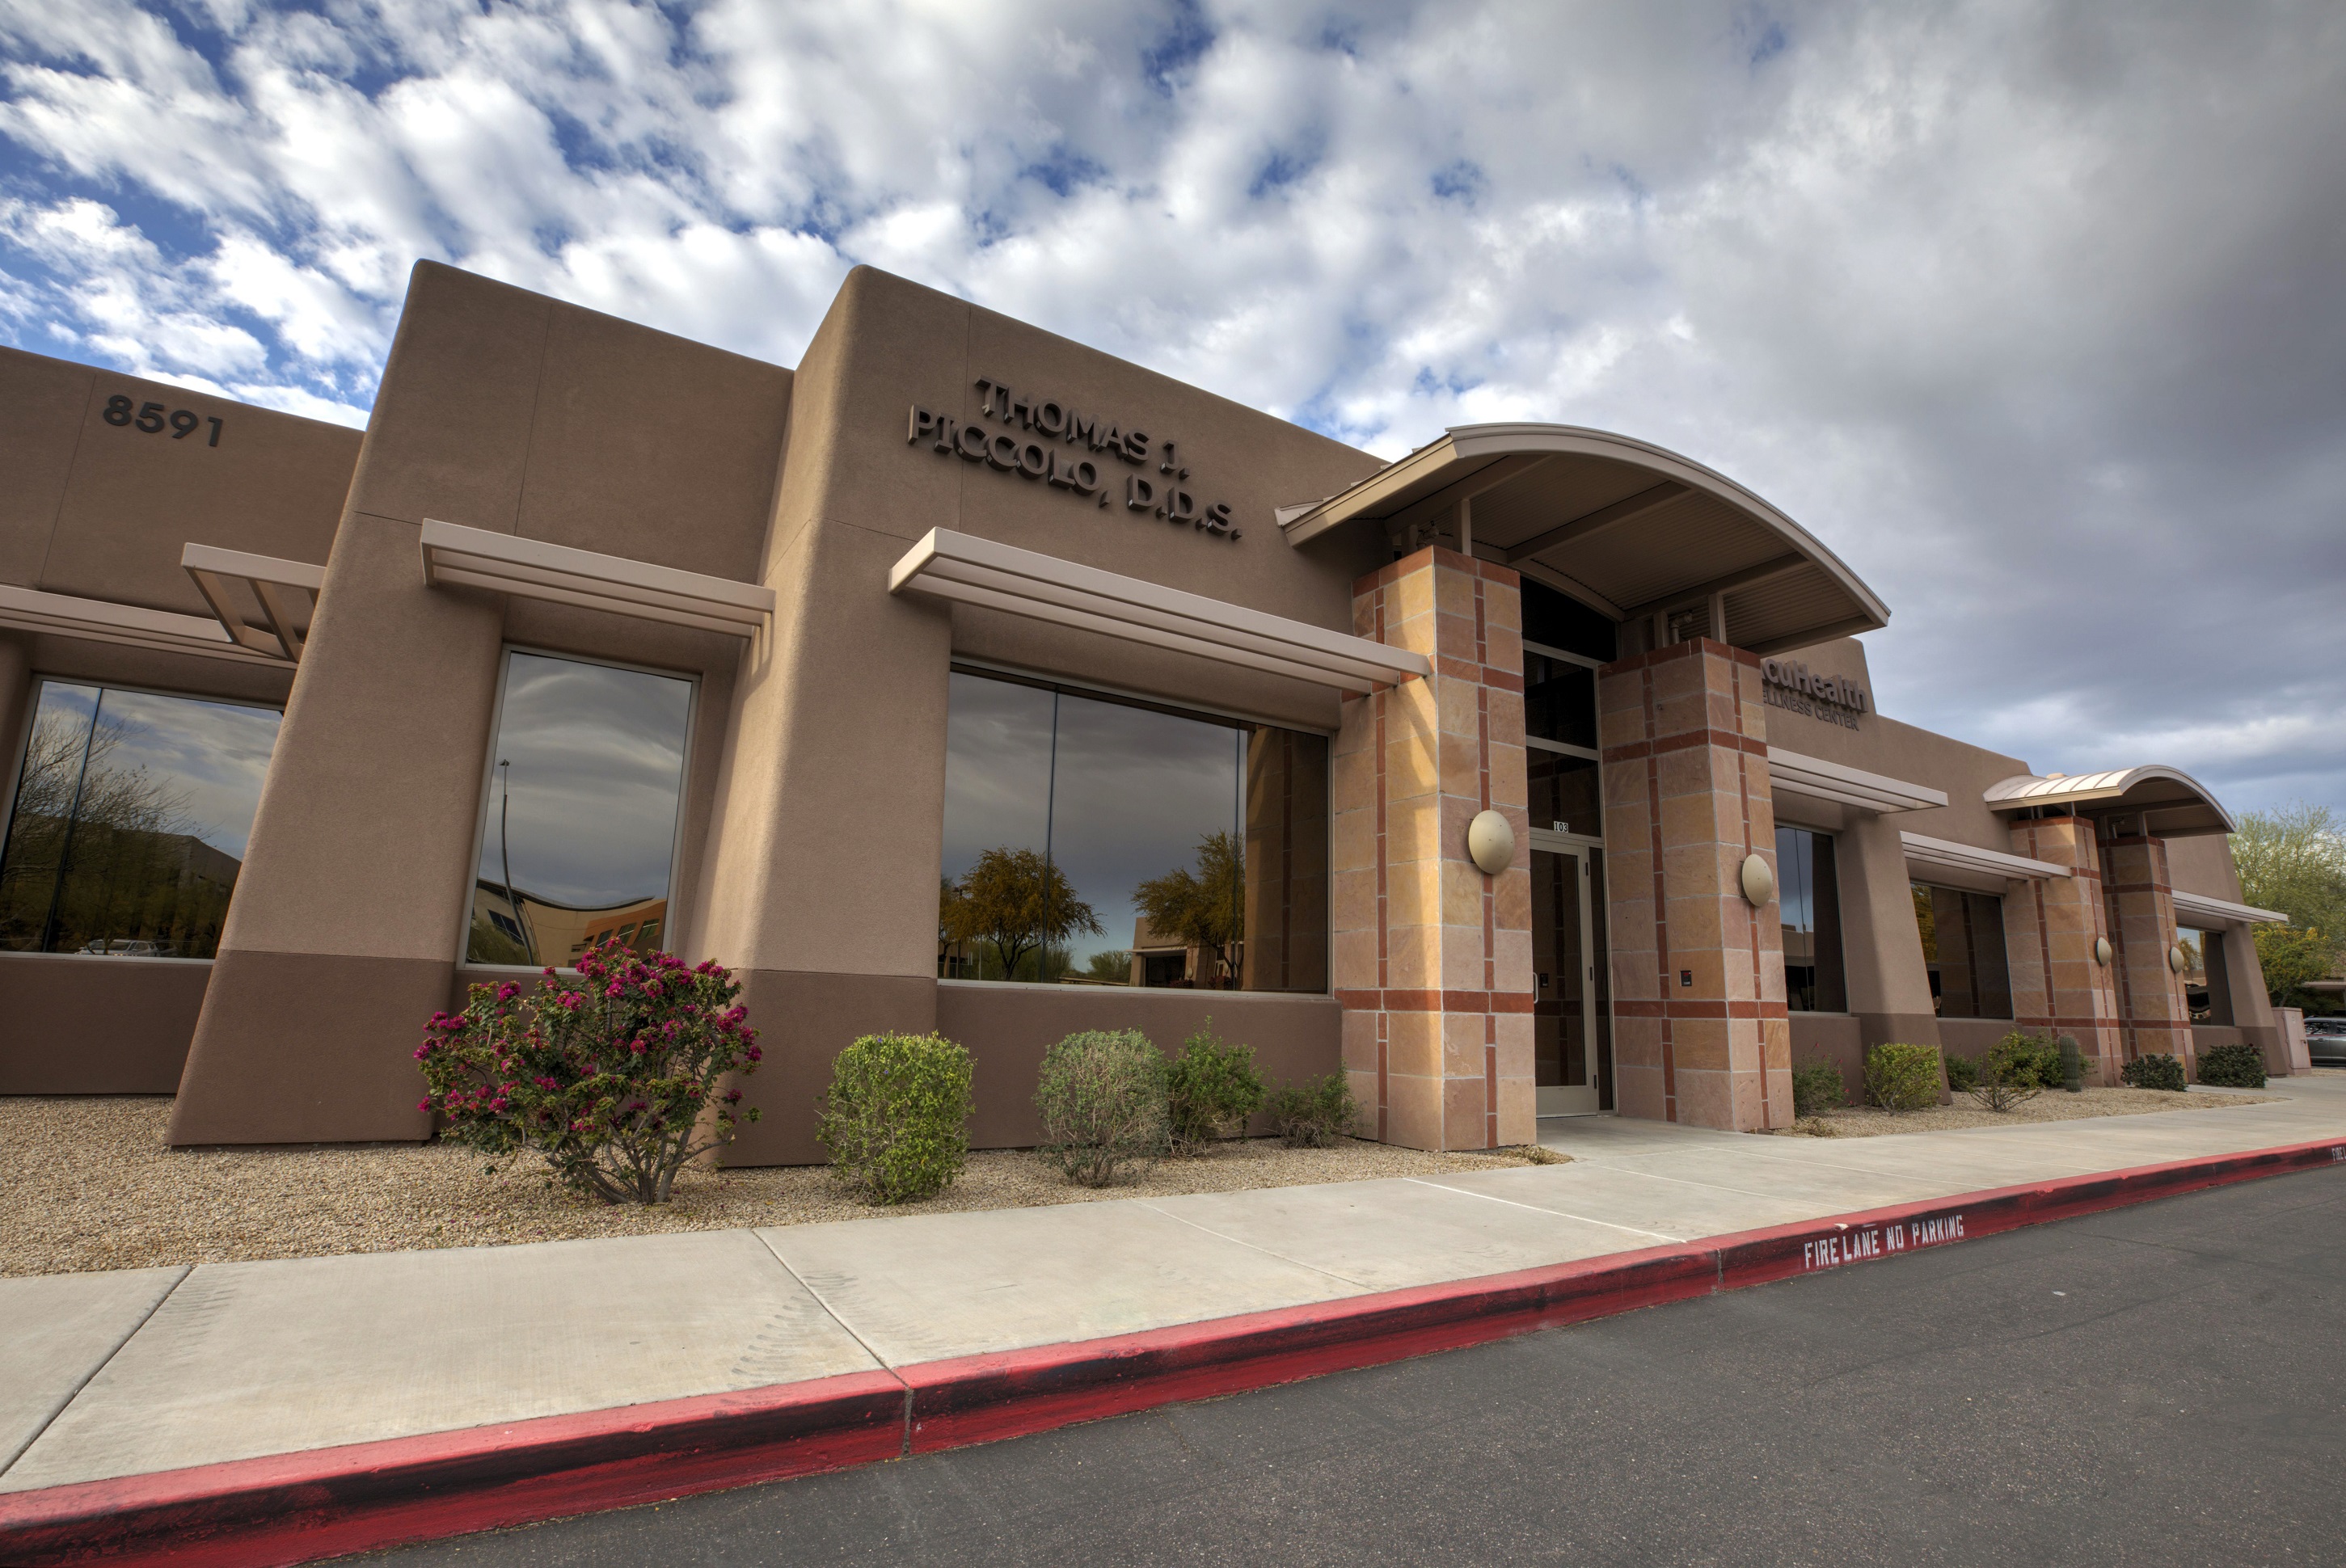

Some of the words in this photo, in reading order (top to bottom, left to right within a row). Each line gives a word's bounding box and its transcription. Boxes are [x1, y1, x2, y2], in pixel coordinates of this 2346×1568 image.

[103, 394, 224, 447] 8591
[974, 374, 1150, 465] THOMAS
[1160, 439, 1191, 480] J.
[907, 404, 1112, 508] PICCOLO,
[1128, 473, 1243, 541] D.D.S.
[1815, 704, 1859, 731] CENTER
[1555, 822, 1568, 832] 103
[1804, 1237, 1839, 1269] FIRE
[1842, 1229, 1880, 1261] LANE
[1886, 1224, 1904, 1250] NO
[1912, 1215, 1964, 1246] PARKING
